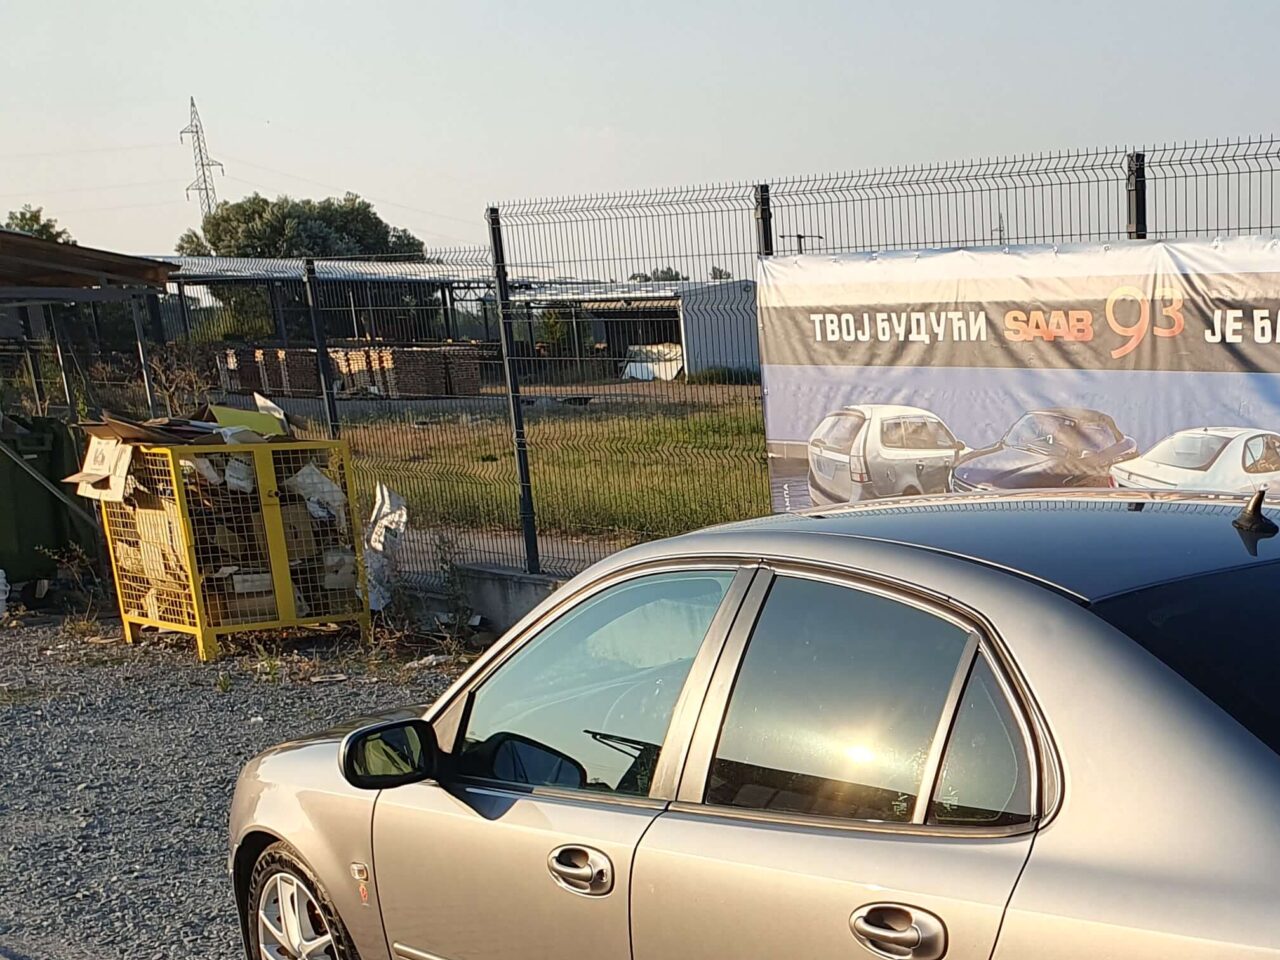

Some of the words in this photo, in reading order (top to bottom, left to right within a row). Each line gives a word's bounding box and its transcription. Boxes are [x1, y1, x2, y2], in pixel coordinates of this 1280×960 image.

[810, 312, 870, 342] ТВОЈ
[878, 310, 988, 345] БУДУЋИ
[1003, 309, 1094, 342] SAAB
[1105, 285, 1186, 360] 93
[1203, 307, 1243, 345] ЈЕ
